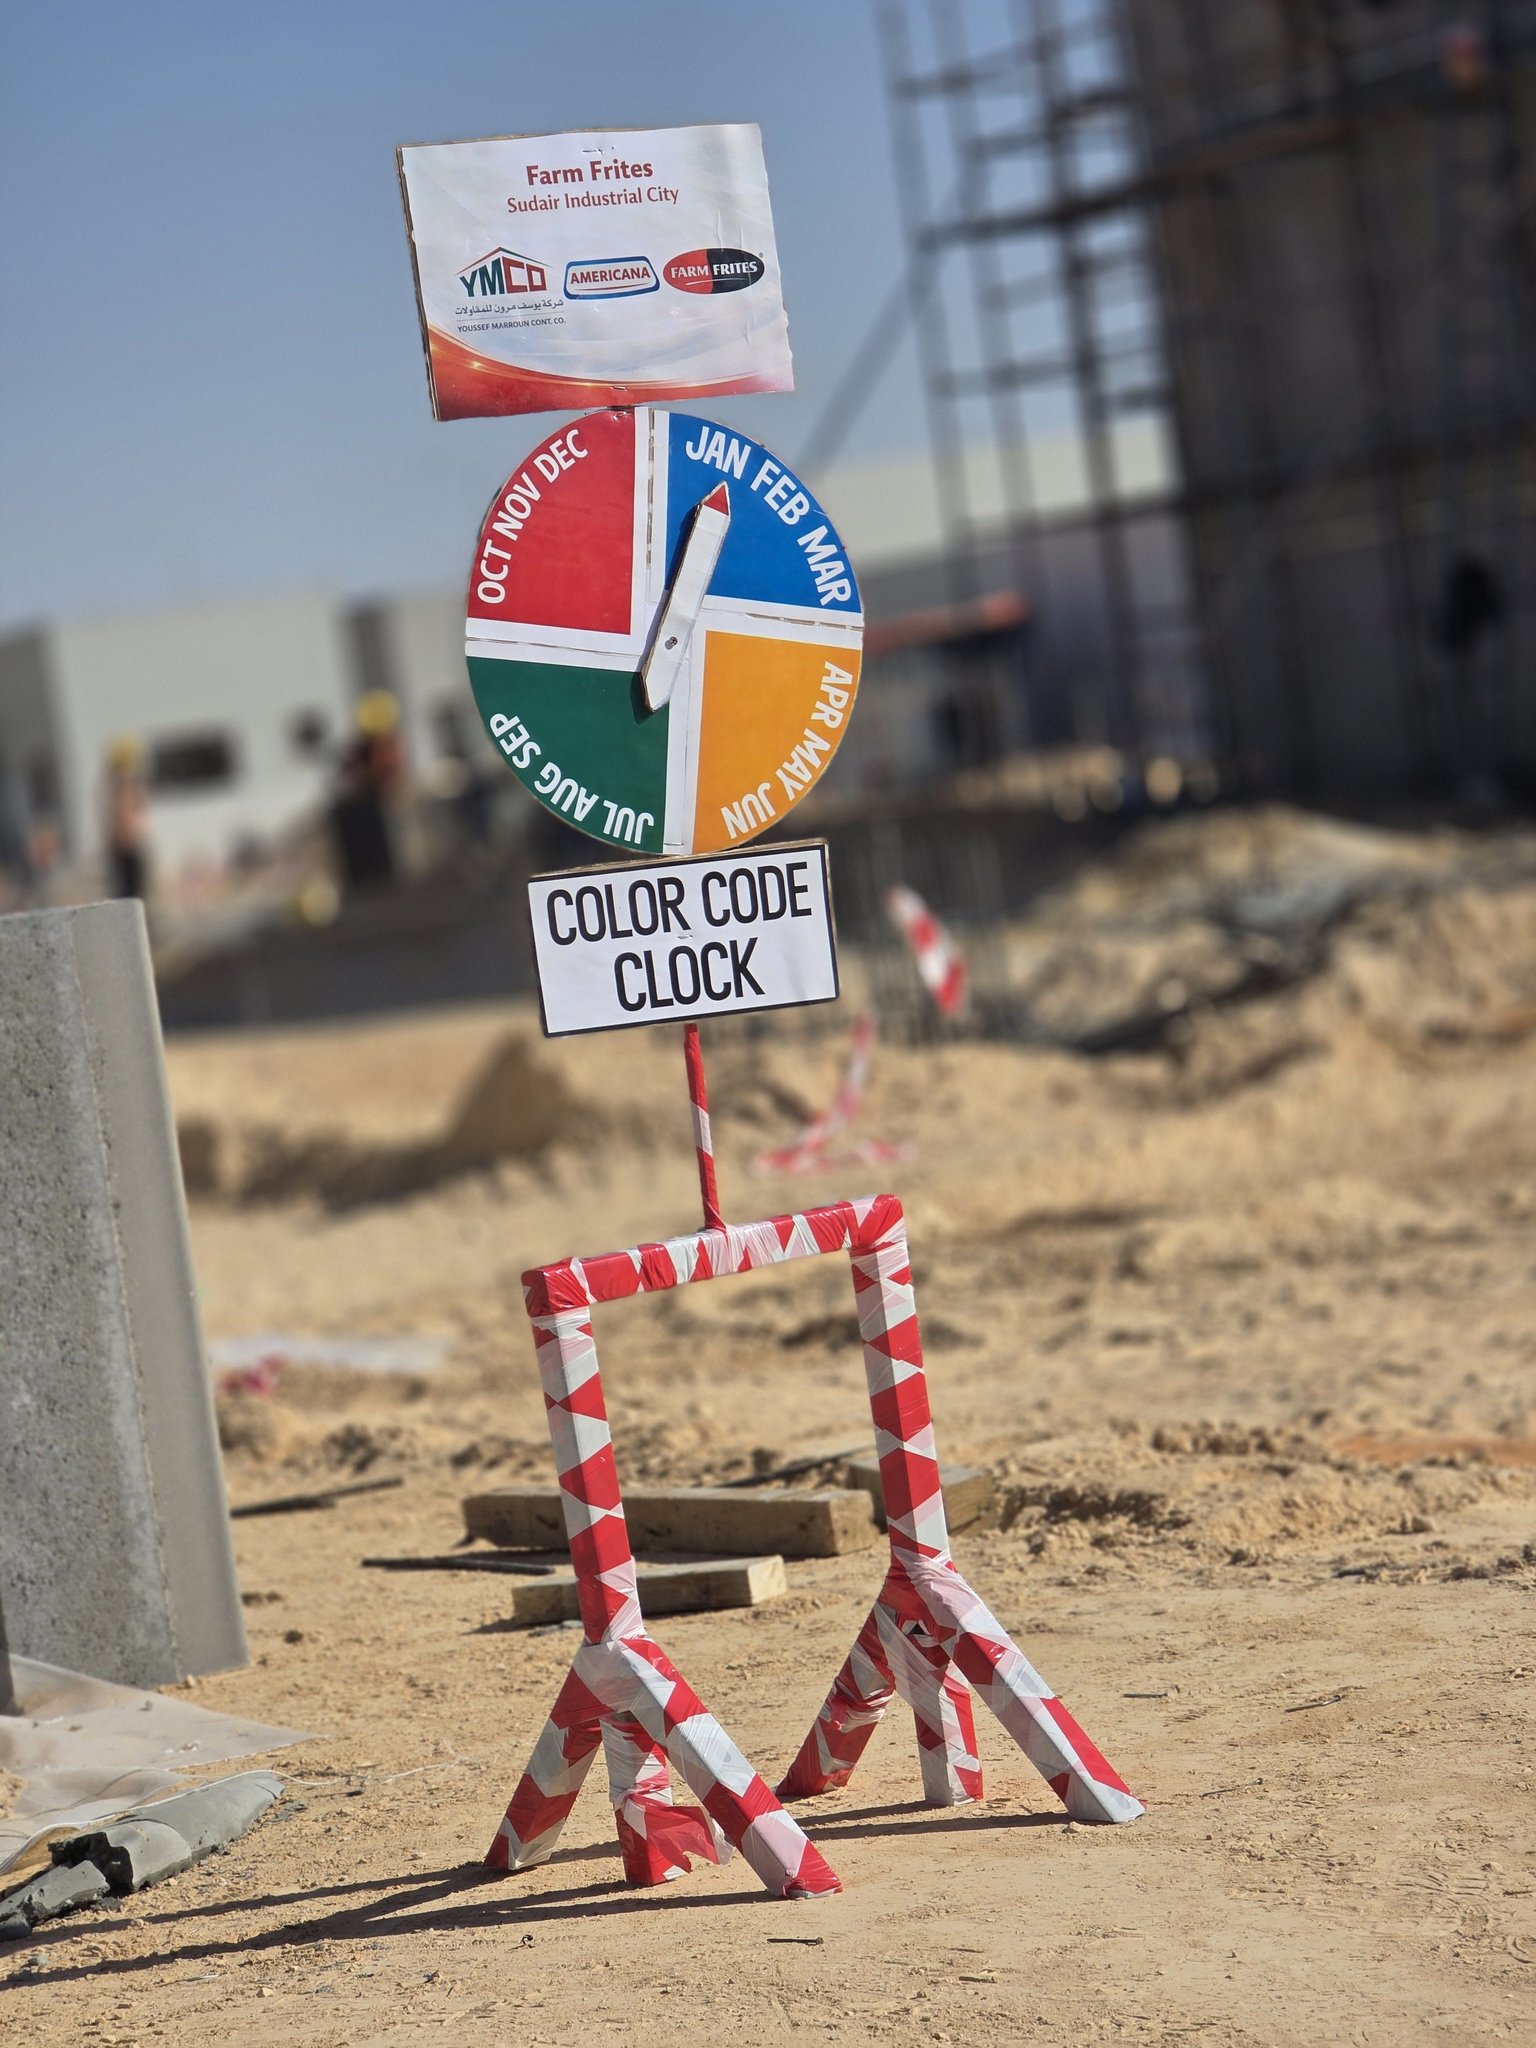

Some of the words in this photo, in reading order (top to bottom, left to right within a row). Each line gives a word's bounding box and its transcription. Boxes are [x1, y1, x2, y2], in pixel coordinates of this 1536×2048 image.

[526, 165, 584, 186] Farm
[590, 160, 654, 182] Frites
[507, 195, 560, 213] Sudair
[565, 189, 643, 209] Industrial
[647, 186, 679, 206] City
[459, 256, 547, 297] YMCO
[570, 266, 651, 285] AMERICANA
[670, 265, 709, 278] FARM
[712, 261, 758, 276] FRITES
[455, 304, 492, 316] للمقاولات
[458, 323, 490, 332] YOUSSEF
[492, 319, 529, 329] MARROUN
[531, 317, 552, 326] CONT.
[494, 305, 516, 313] مرون
[518, 302, 541, 311] يوسف
[542, 299, 564, 309] شركة
[533, 429, 589, 483] DEC
[492, 472, 541, 541] NOV
[686, 426, 751, 479] JAN
[750, 459, 810, 525] FEB
[797, 526, 852, 606] MAR
[477, 539, 512, 604] OCT
[810, 661, 853, 729] APR
[489, 712, 542, 770] SEP
[780, 728, 831, 801] MAY
[533, 762, 599, 821] AUG
[720, 782, 777, 839] JUN
[603, 799, 655, 844] JUL
[547, 876, 691, 946] COLOR
[701, 861, 812, 927] CODE
[614, 937, 765, 1012] CLOCK
